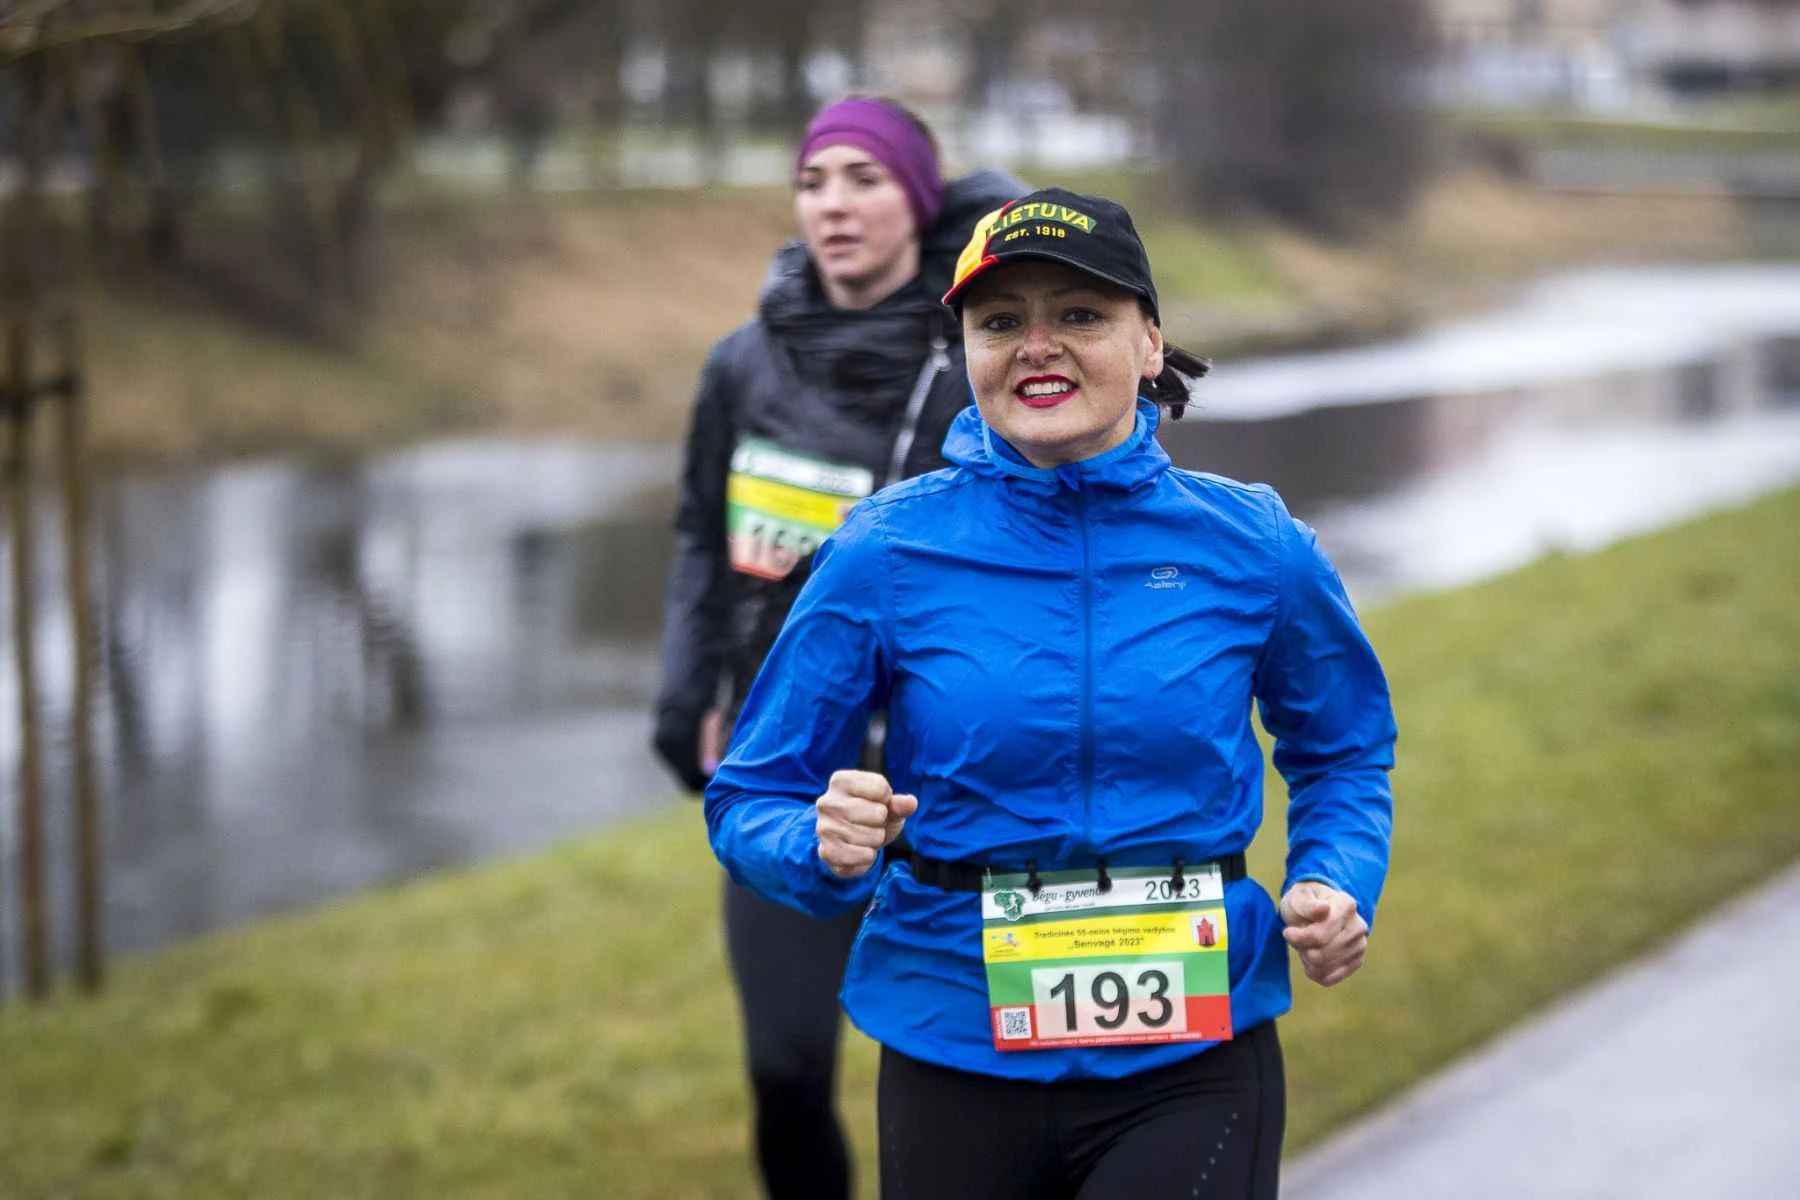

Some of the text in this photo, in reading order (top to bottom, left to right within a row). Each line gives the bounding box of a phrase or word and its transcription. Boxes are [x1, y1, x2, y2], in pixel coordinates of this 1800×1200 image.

[990, 203, 1090, 235] LIETUVA
[1004, 225, 1066, 241] EST. 1918
[1050, 969, 1173, 1032] 193
